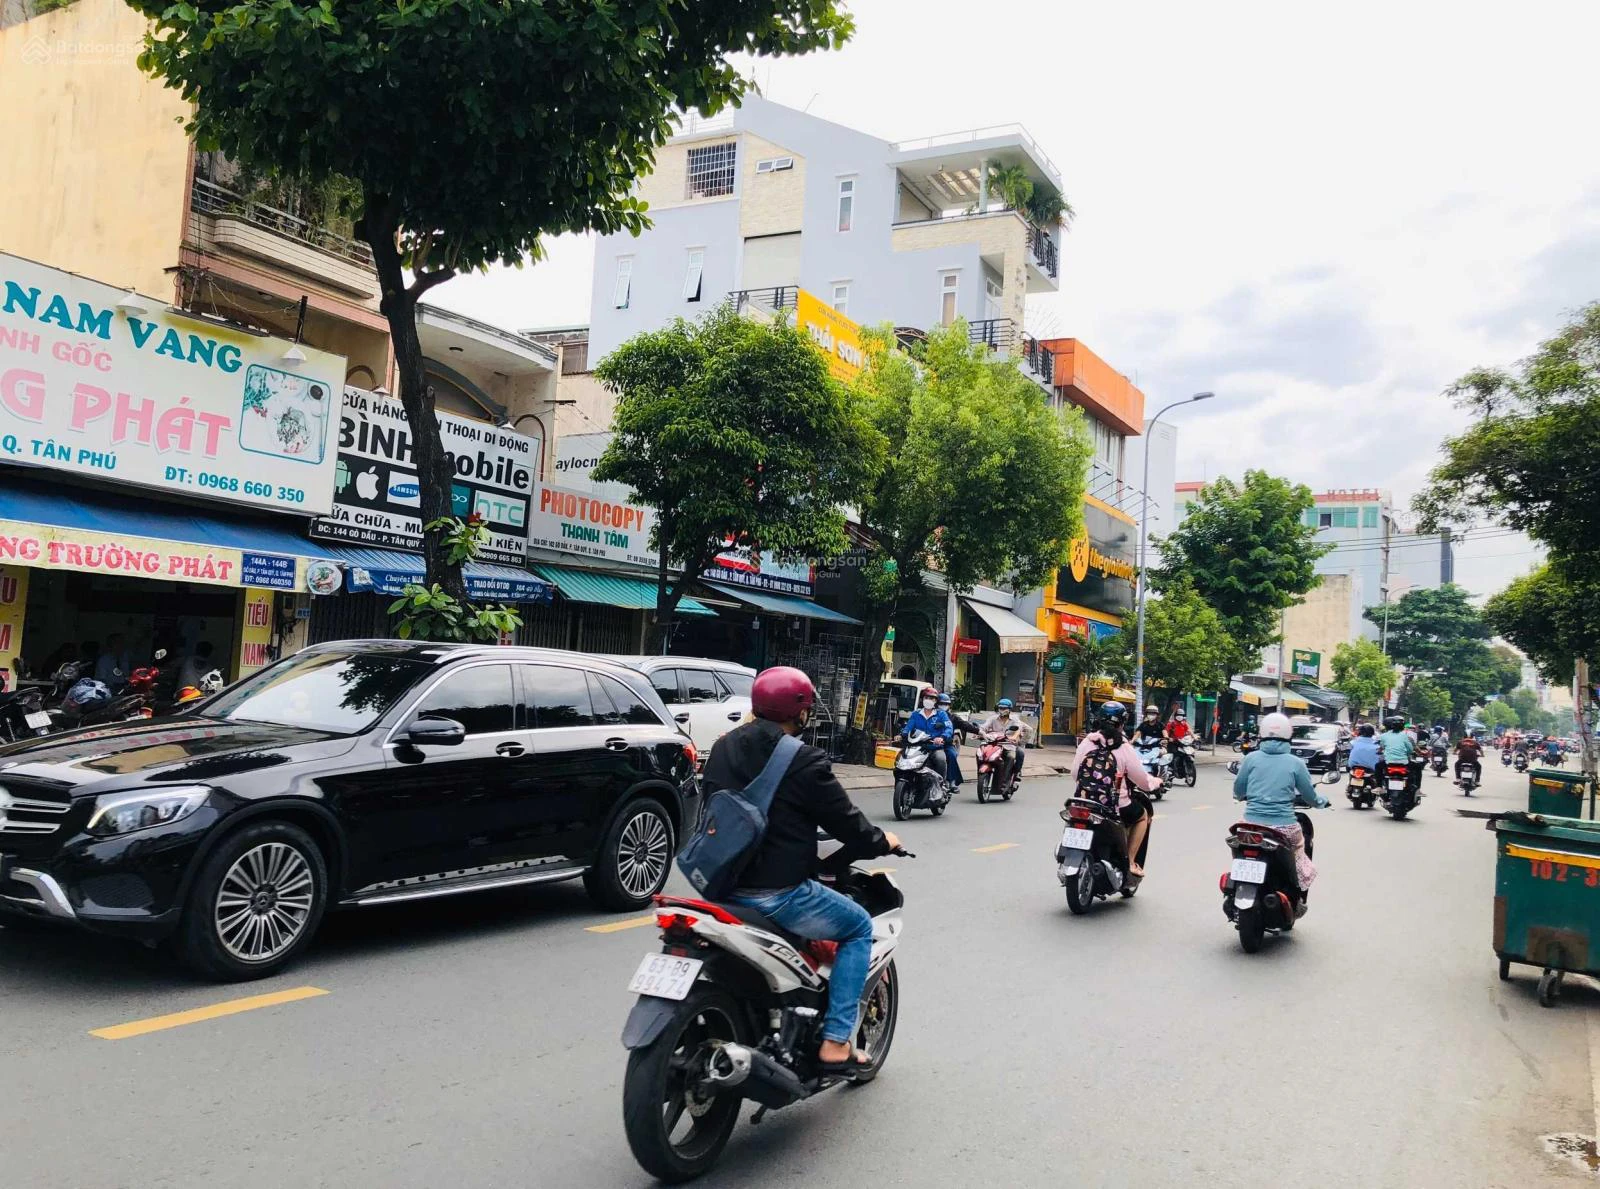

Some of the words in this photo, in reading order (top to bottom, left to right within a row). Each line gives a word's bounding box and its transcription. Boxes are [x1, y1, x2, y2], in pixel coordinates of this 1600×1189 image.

[2, 281, 113, 340] NAM
[126, 317, 243, 373] VANG
[52, 341, 112, 372] GỐC
[67, 382, 234, 460] PHÁT
[342, 391, 368, 412] CỬA
[372, 400, 408, 421] HÀNG
[2, 434, 22, 453] Q.
[31, 439, 71, 462] TÂN
[77, 449, 117, 470] PHÚ
[446, 421, 480, 442] THOẠI
[484, 428, 497, 446] DI
[499, 435, 529, 453] ĐỘNG
[165, 466, 193, 484] ĐT:
[198, 472, 239, 493] 0968
[243, 481, 273, 498] 660
[276, 486, 305, 503] 350
[1327, 488, 1379, 500] HOTEL
[354, 511, 391, 529] CHỮA
[540, 487, 645, 532] PHOTOCOPY
[317, 524, 331, 534] ĐC:
[333, 527, 346, 536] 144
[349, 529, 360, 538] GÒ
[361, 529, 376, 541] DẦU
[382, 535, 389, 544] P.
[391, 535, 405, 545] TÂN
[496, 537, 523, 552] KIỆN
[561, 523, 600, 543] THANH
[604, 530, 629, 548] TÂM
[48, 542, 160, 573] TRƯỜNG
[168, 553, 232, 580] PHÁT
[243, 643, 266, 666] NAM
